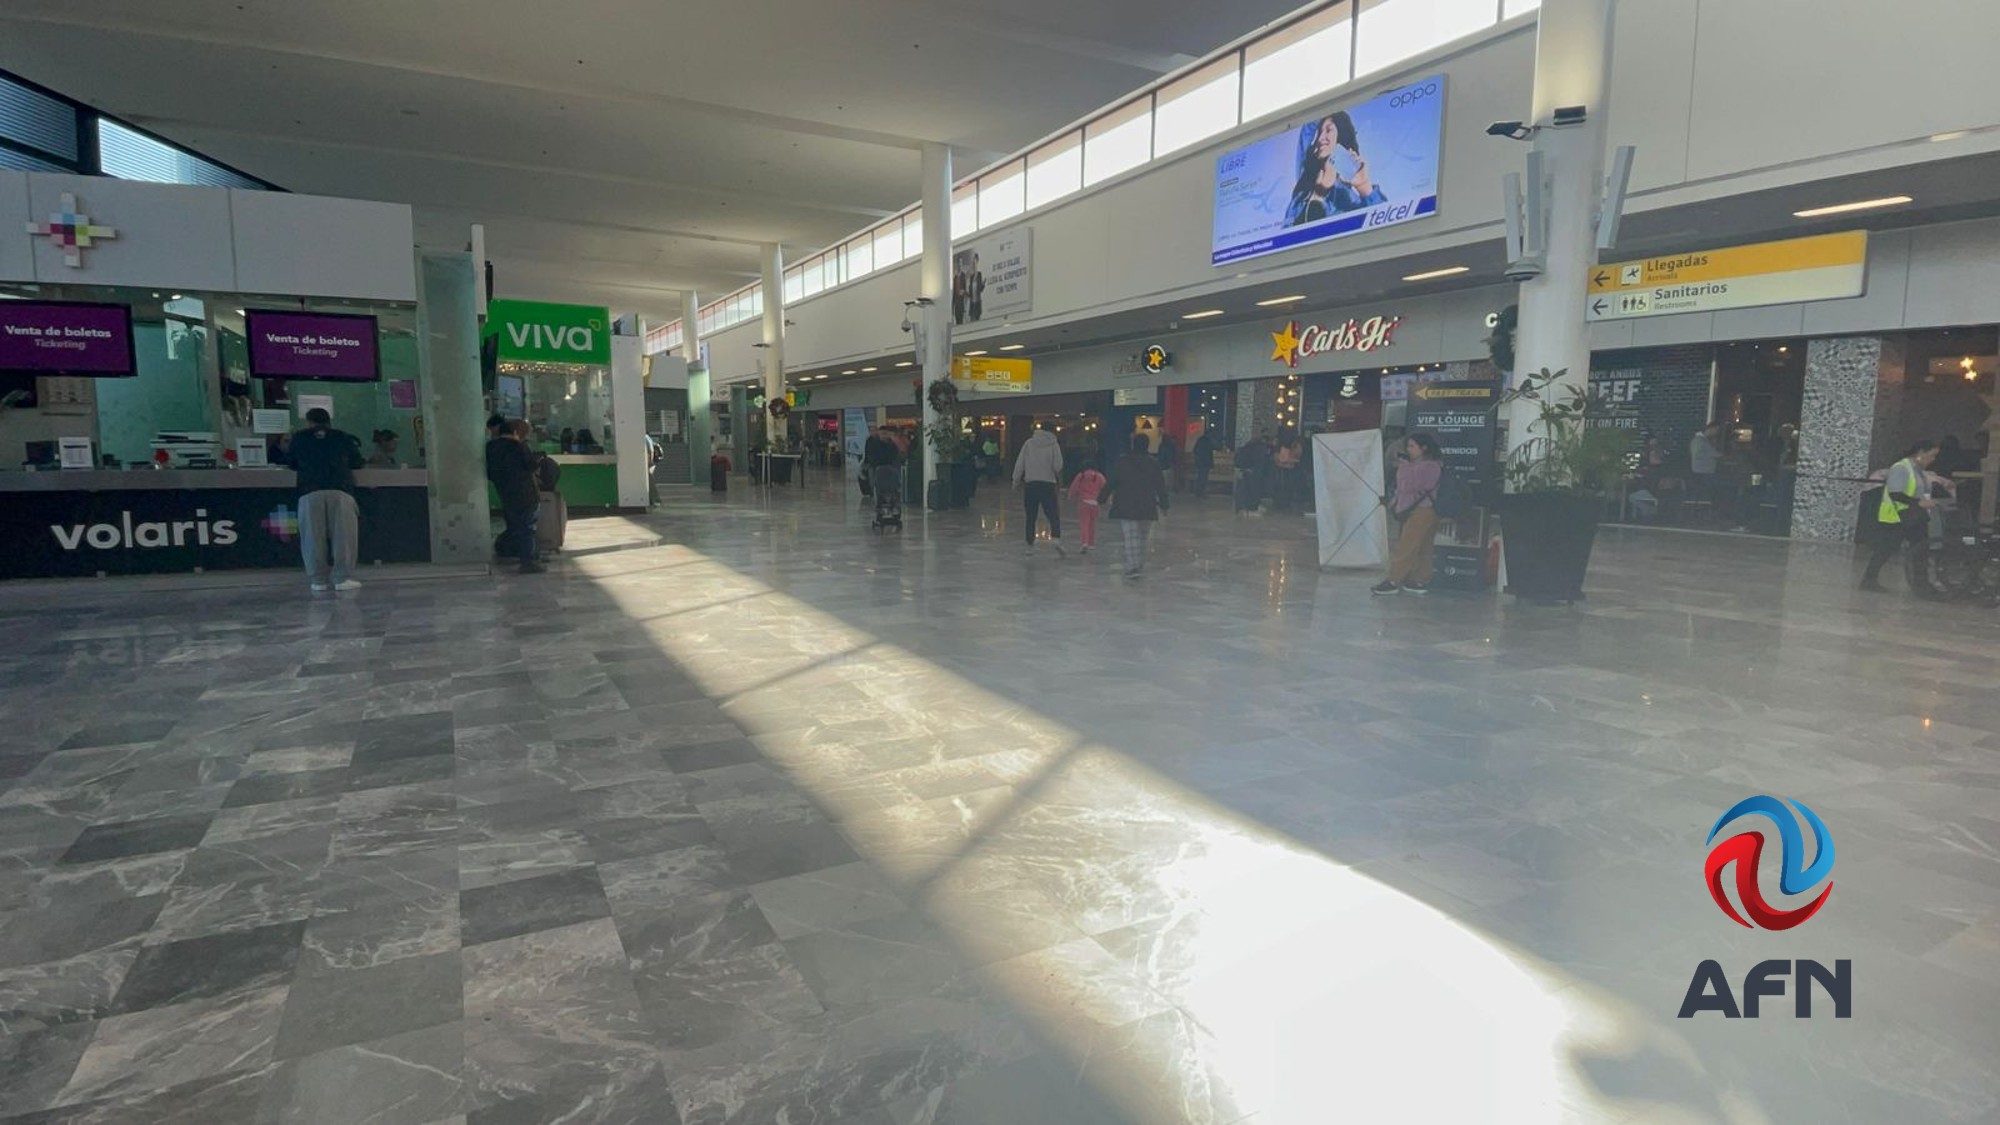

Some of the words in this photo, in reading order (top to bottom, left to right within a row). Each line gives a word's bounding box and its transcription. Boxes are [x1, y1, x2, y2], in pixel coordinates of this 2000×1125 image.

[1390, 83, 1437, 108] oppo
[1220, 156, 1247, 174] LIBRE
[1368, 200, 1414, 227] telcel
[1646, 254, 1708, 272] Llegadas
[1655, 282, 1728, 300] Sanitarios
[1654, 300, 1697, 310] Restrooms
[4, 325, 42, 336] Venta
[45, 326, 61, 337] de
[64, 326, 112, 338] boletos
[266, 333, 299, 344] Venta
[302, 335, 316, 345] de
[319, 336, 360, 347] boletos
[506, 322, 593, 351] viva
[1298, 318, 1357, 357] Carl's
[34, 339, 86, 351] Ticketing
[293, 346, 338, 358] Ticketing
[1417, 415, 1435, 424] VIP
[1438, 415, 1485, 424] LOUNGE
[1615, 418, 1638, 429] FIRE
[50, 508, 239, 550] volaris
